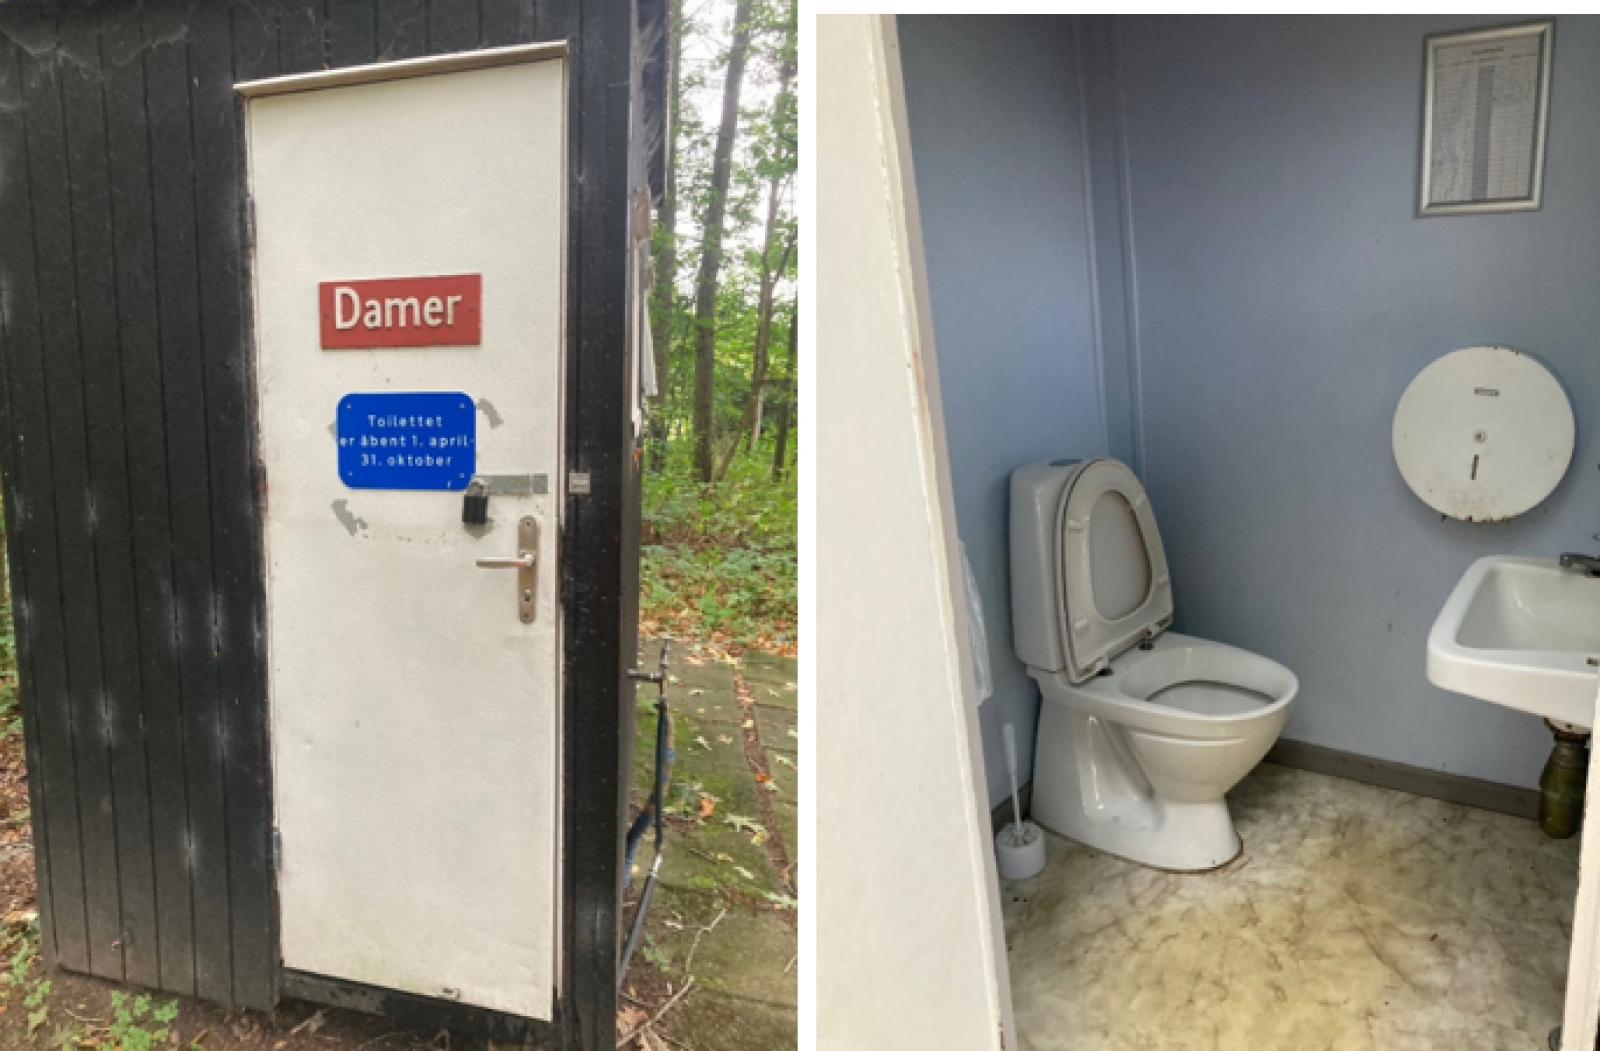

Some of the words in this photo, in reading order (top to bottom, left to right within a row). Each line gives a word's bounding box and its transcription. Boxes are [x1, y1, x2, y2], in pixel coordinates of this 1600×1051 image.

[334, 286, 462, 330] Damer
[367, 415, 443, 427] Toilettet
[339, 436, 355, 446] er
[360, 433, 406, 447] åbent
[412, 434, 424, 447] 1.
[361, 453, 382, 466] 31.
[386, 453, 453, 466] oktober
